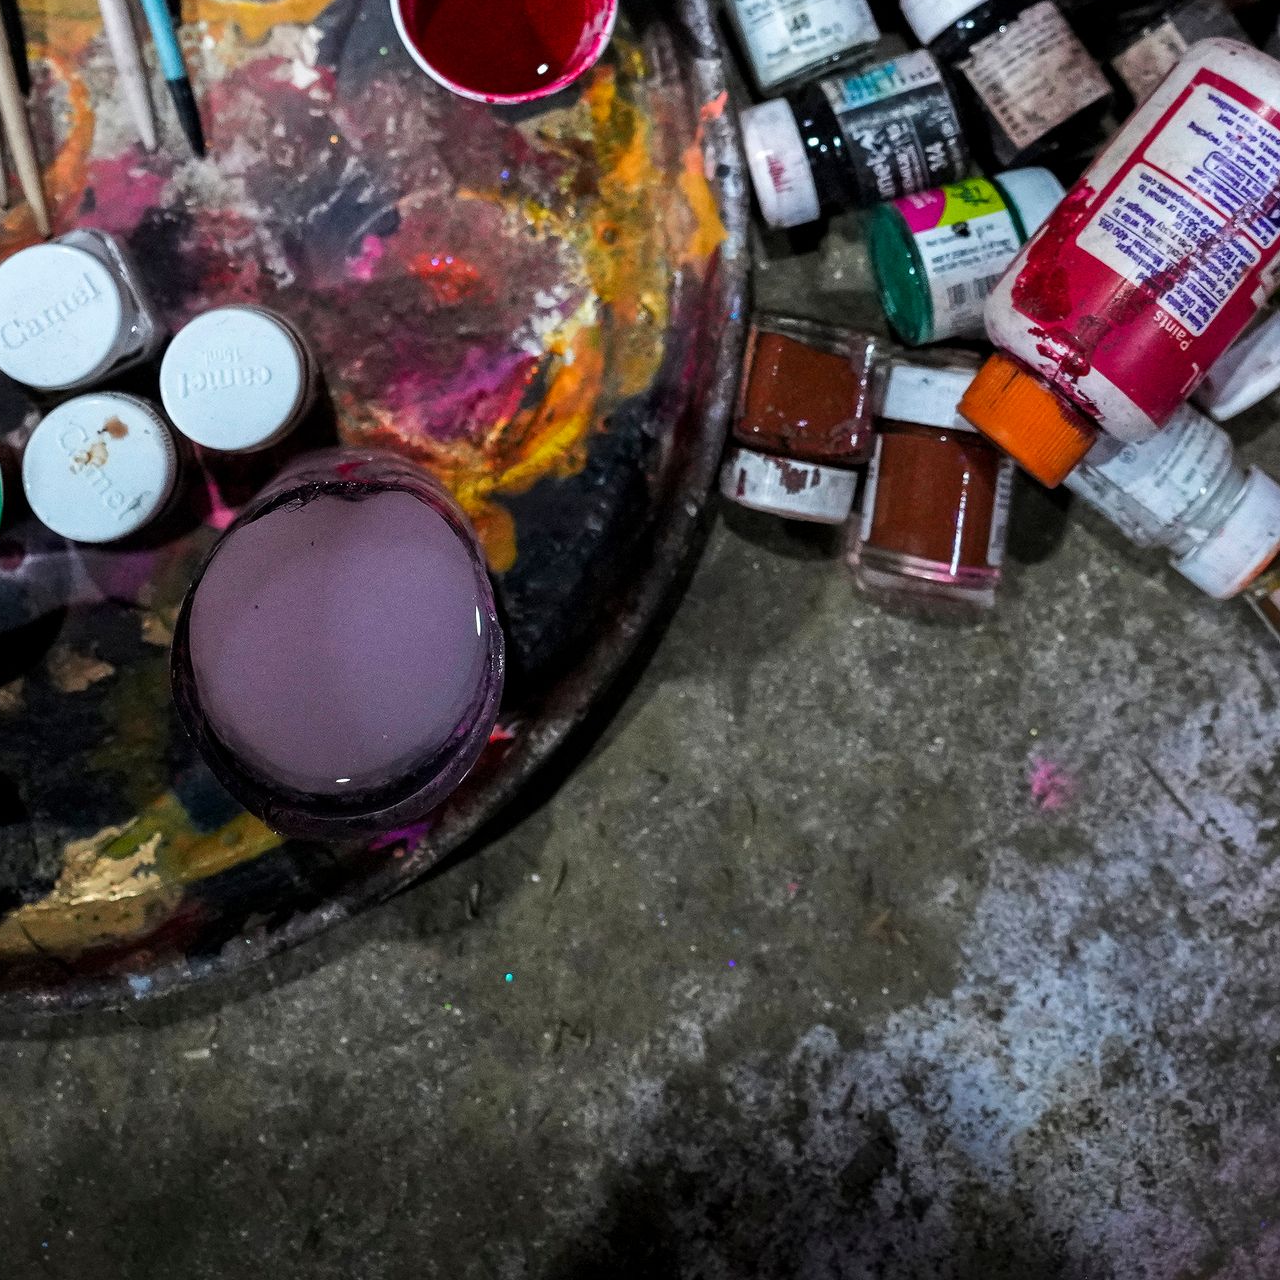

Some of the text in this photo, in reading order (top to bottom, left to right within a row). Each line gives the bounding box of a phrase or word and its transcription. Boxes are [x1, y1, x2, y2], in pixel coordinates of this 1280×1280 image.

[1137, 183, 1147, 192] to
[1115, 195, 1125, 204] at
[1145, 189, 1167, 206] email
[1111, 207, 1121, 216] to
[1124, 198, 1156, 226] Manager
[1166, 203, 1176, 212] or
[1120, 212, 1139, 228] write
[1172, 220, 1182, 230] or
[1111, 226, 1129, 241] 400
[1224, 277, 1235, 290] the
[1173, 285, 1195, 308] Office:
[1215, 286, 1227, 301] For
[1164, 294, 1203, 331] Asian Paints
[1152, 310, 1191, 351] Paints
